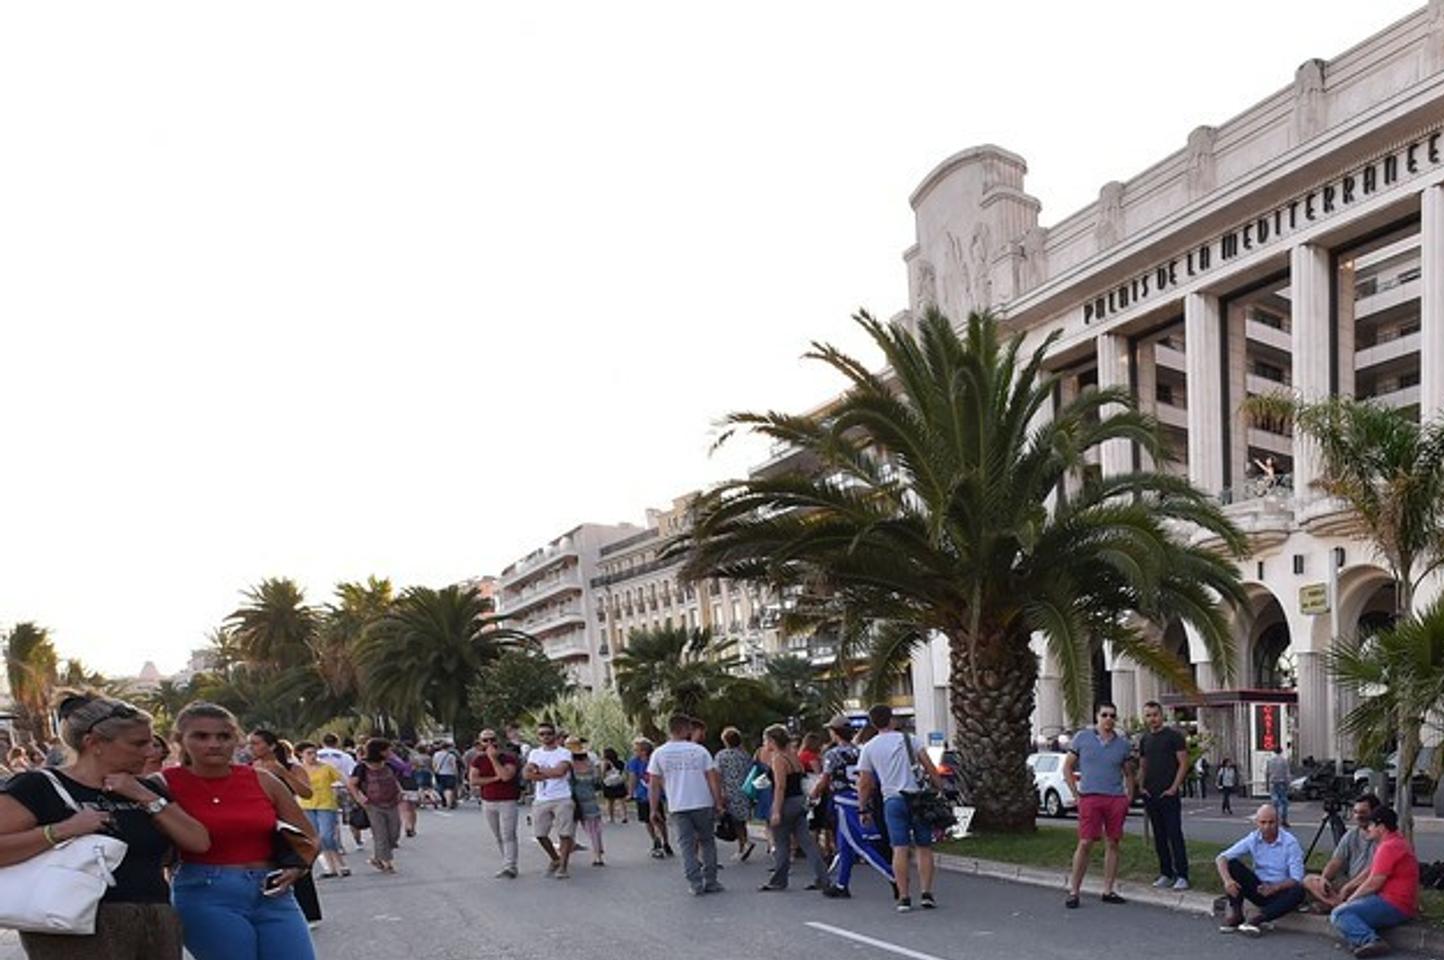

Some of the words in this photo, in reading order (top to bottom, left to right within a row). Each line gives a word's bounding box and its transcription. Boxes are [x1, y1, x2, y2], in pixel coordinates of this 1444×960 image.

[1083, 274, 1149, 325] PALAIS
[1157, 261, 1177, 290] DE
[1187, 246, 1210, 276] LA
[1221, 132, 1441, 261] MEDITERRANEE
[1262, 705, 1274, 751] CASINO
